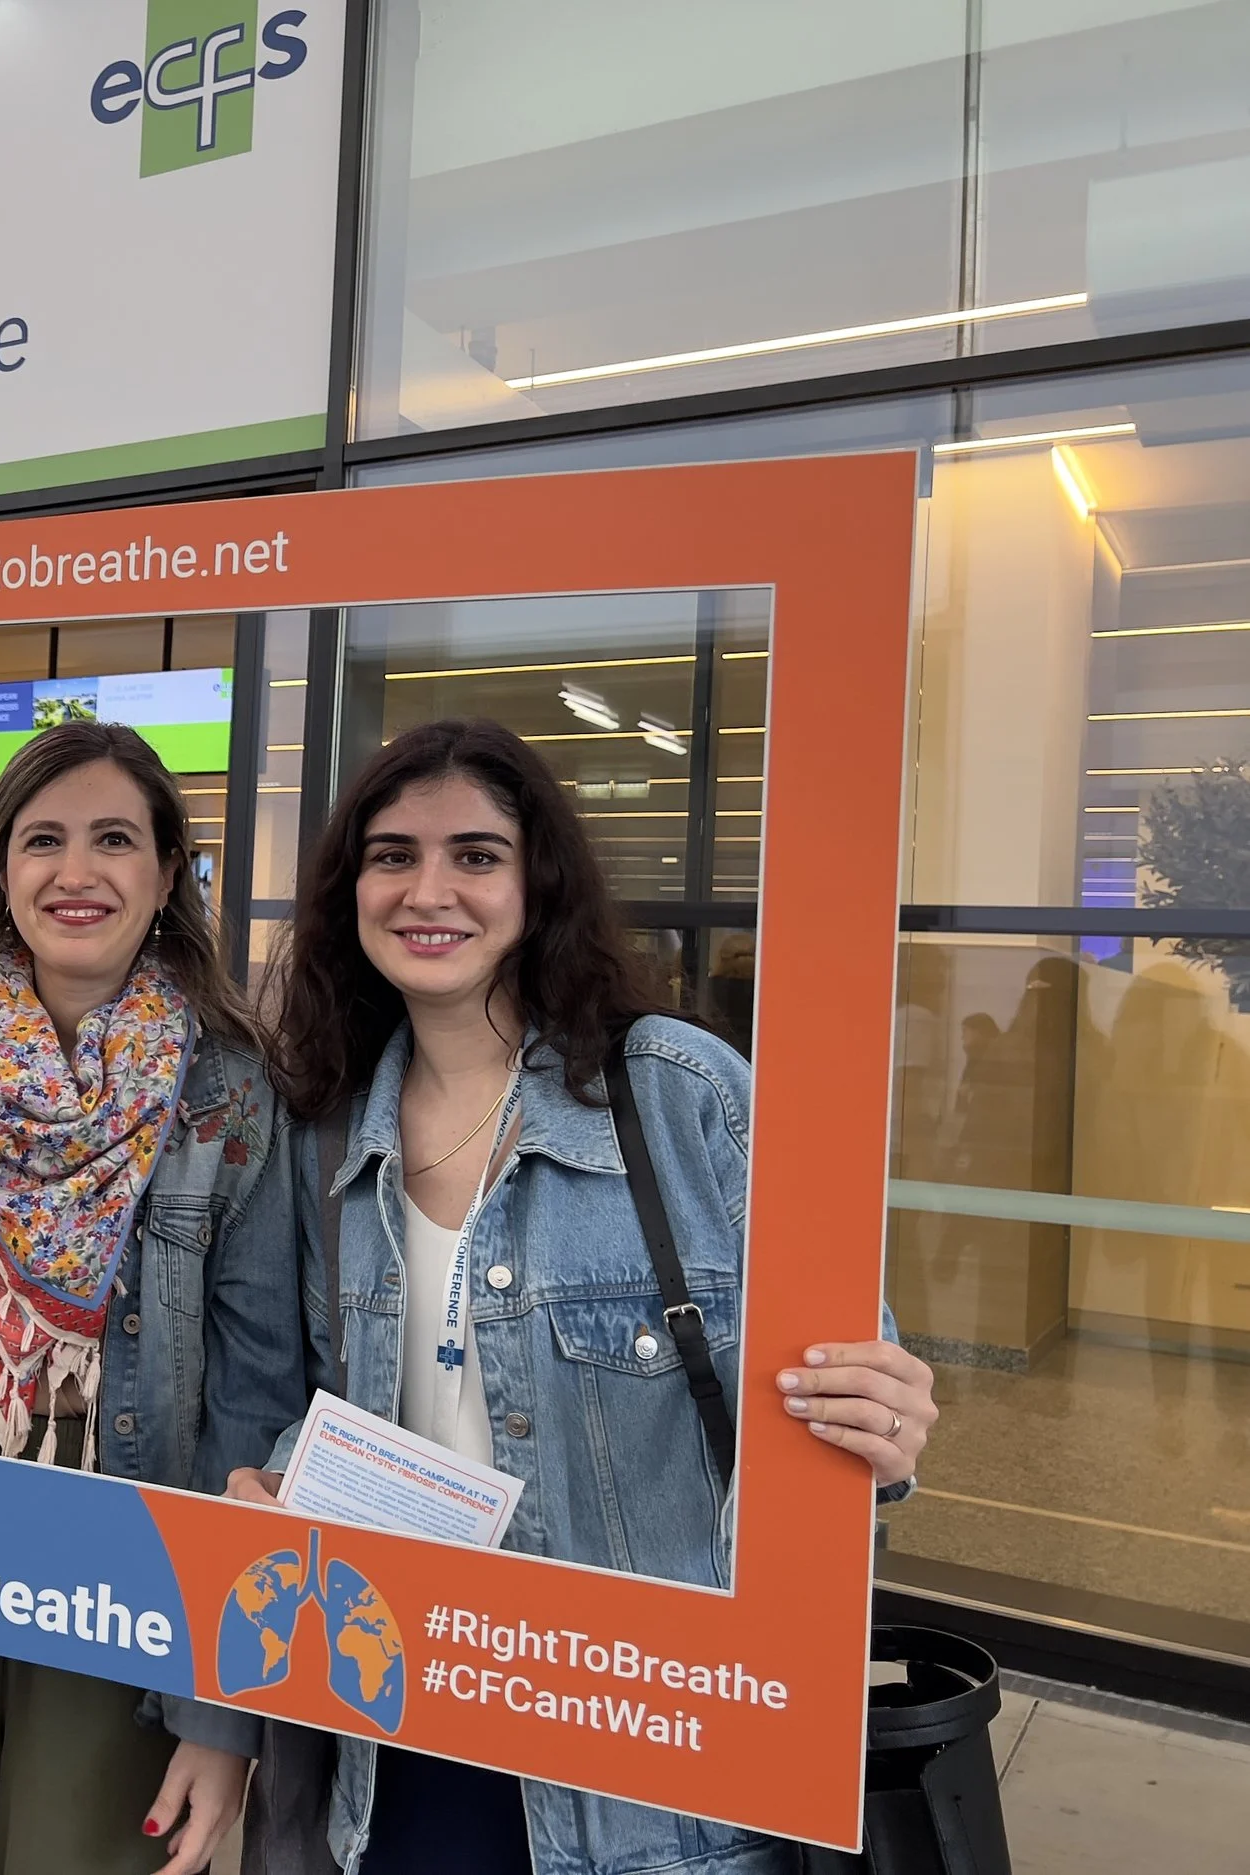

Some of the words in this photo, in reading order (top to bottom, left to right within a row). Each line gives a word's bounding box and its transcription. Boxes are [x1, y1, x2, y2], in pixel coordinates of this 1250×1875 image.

[90, 9, 308, 153] ecfs
[446, 1236, 467, 1328] CONFERENCE
[319, 1430, 366, 1457] EUROPEAN
[365, 1452, 398, 1473] CYSTIC
[397, 1467, 437, 1490] FIBROSIS
[437, 1485, 496, 1516] CONFERENCE
[321, 1420, 338, 1434] THE
[338, 1429, 365, 1446] RIGHT
[366, 1442, 378, 1453] TO
[378, 1448, 419, 1472] BREATHE
[418, 1467, 467, 1493] CAMPAIGN
[466, 1489, 481, 1499] AT
[481, 1493, 499, 1507] THE
[423, 1604, 788, 1710] #RightToBreathe
[421, 1658, 703, 1752] #CFCantWait
